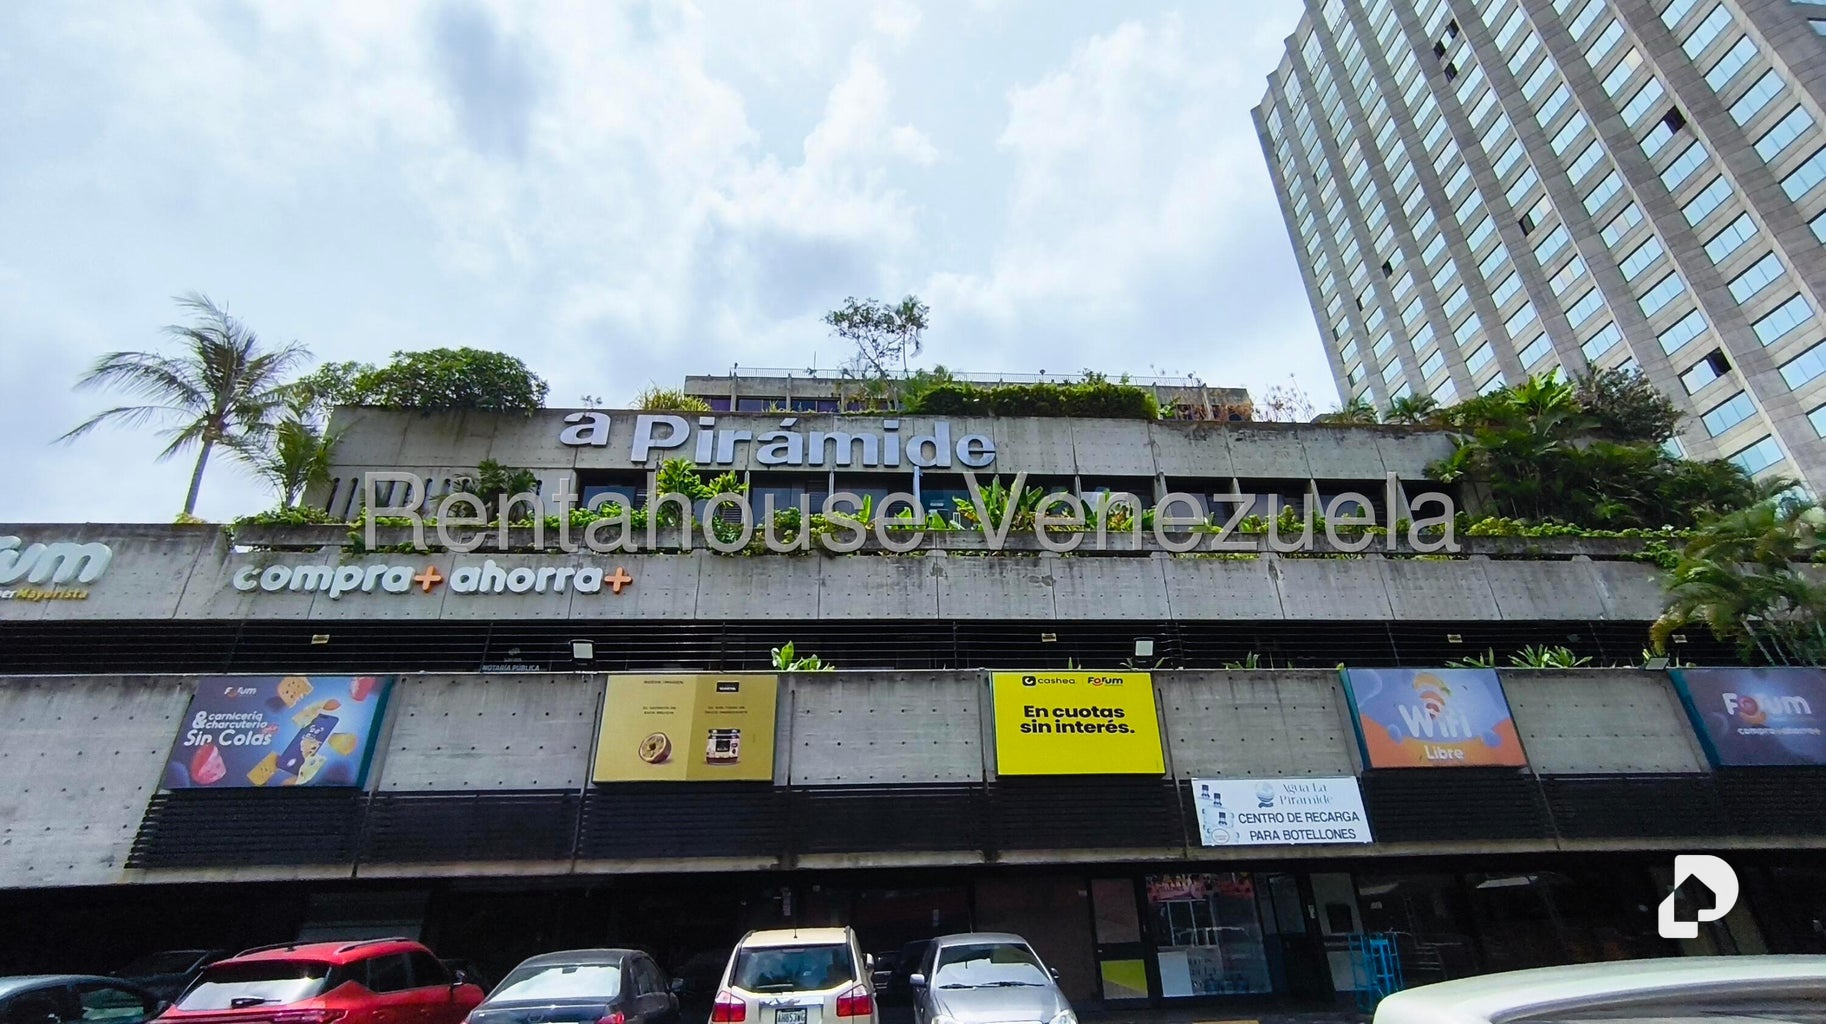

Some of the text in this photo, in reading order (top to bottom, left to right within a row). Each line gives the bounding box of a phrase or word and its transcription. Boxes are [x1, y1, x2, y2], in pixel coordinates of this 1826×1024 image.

[630, 414, 997, 468] Pirámide
[1088, 676, 1124, 686] Forum
[1024, 705, 1125, 718] En cuotas
[1722, 692, 1812, 718] Forum
[1020, 719, 1136, 734] sin interés.
[183, 729, 213, 746] Sin
[218, 729, 272, 746] Colas
[1425, 744, 1465, 760] Libre
[1238, 811, 1360, 824] CENTRO DE RECARGA
[1250, 829, 1357, 841] PARA BOTELLONES
